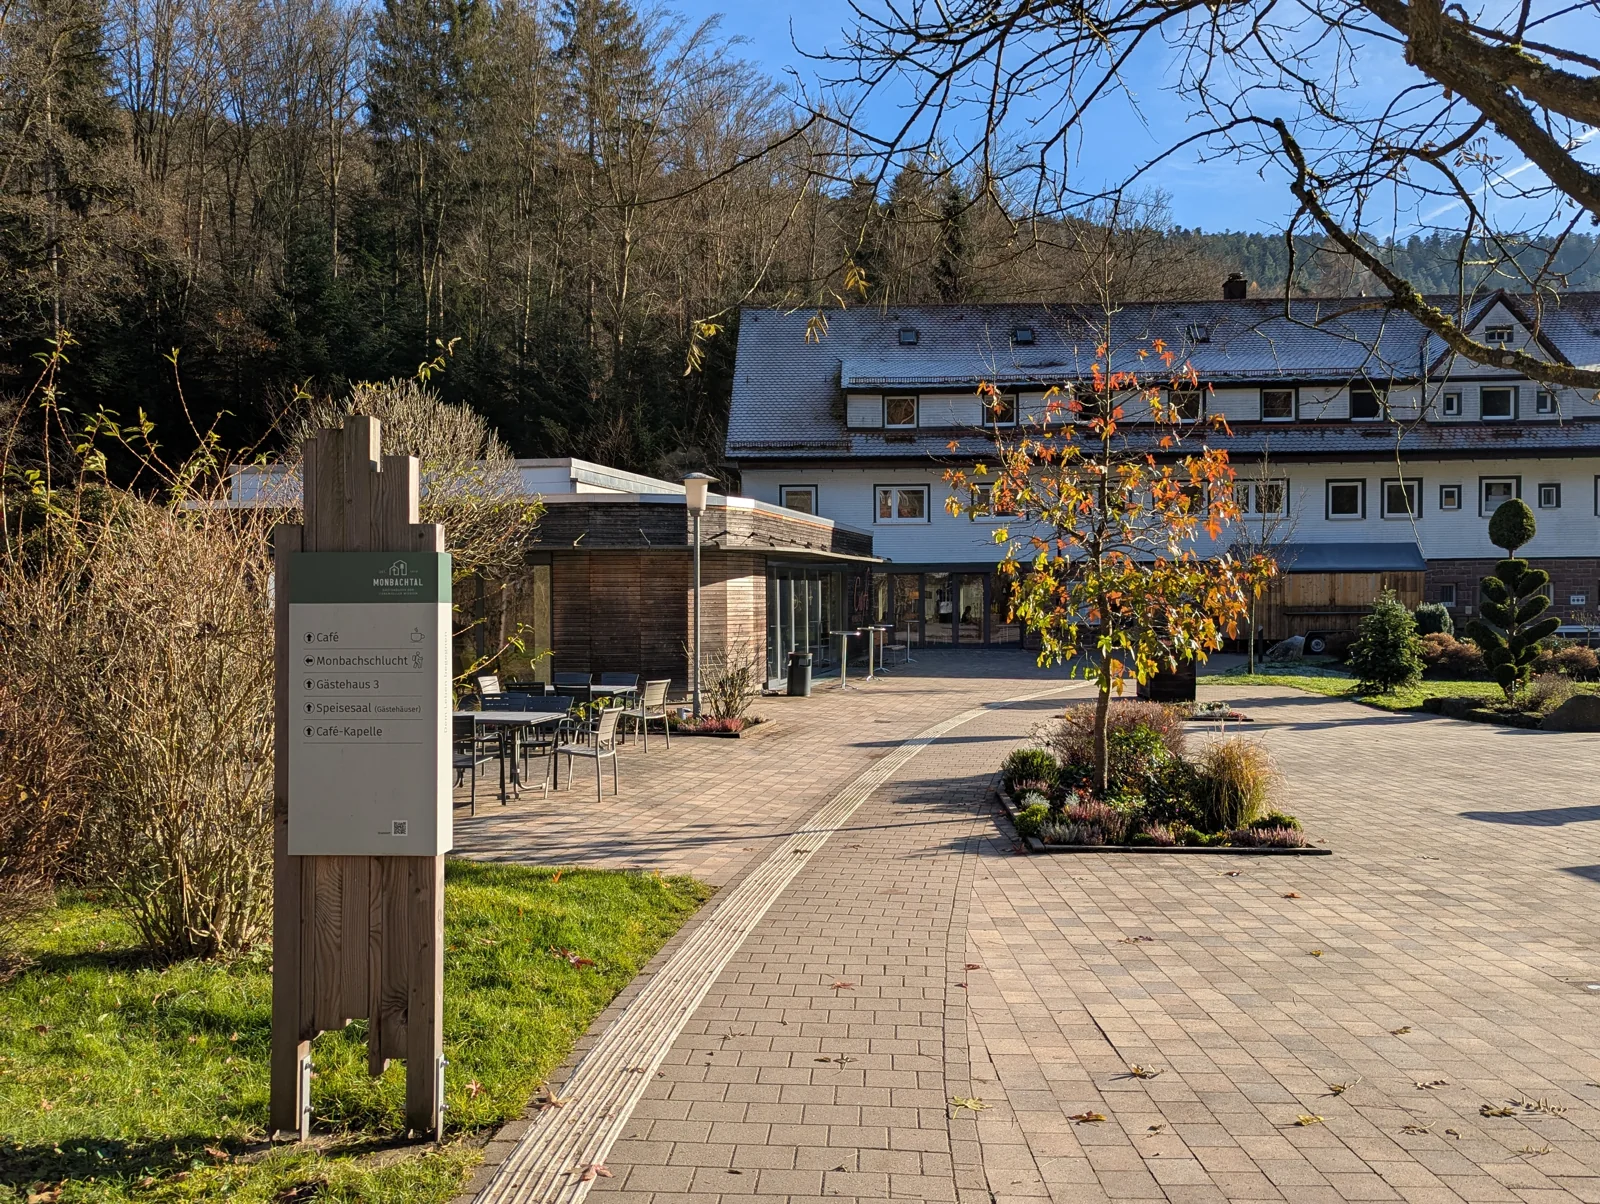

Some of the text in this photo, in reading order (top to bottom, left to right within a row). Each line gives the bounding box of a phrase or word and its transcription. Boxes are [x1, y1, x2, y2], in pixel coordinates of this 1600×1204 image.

[373, 578, 423, 587] MONBACHTAL
[316, 631, 340, 643] Café
[316, 655, 409, 666] Monbachschlucht
[316, 679, 380, 689] Gästehaus 3
[316, 702, 422, 715] Speisesaal (Gästehäuser)
[316, 725, 383, 738] Café-Kapelle
